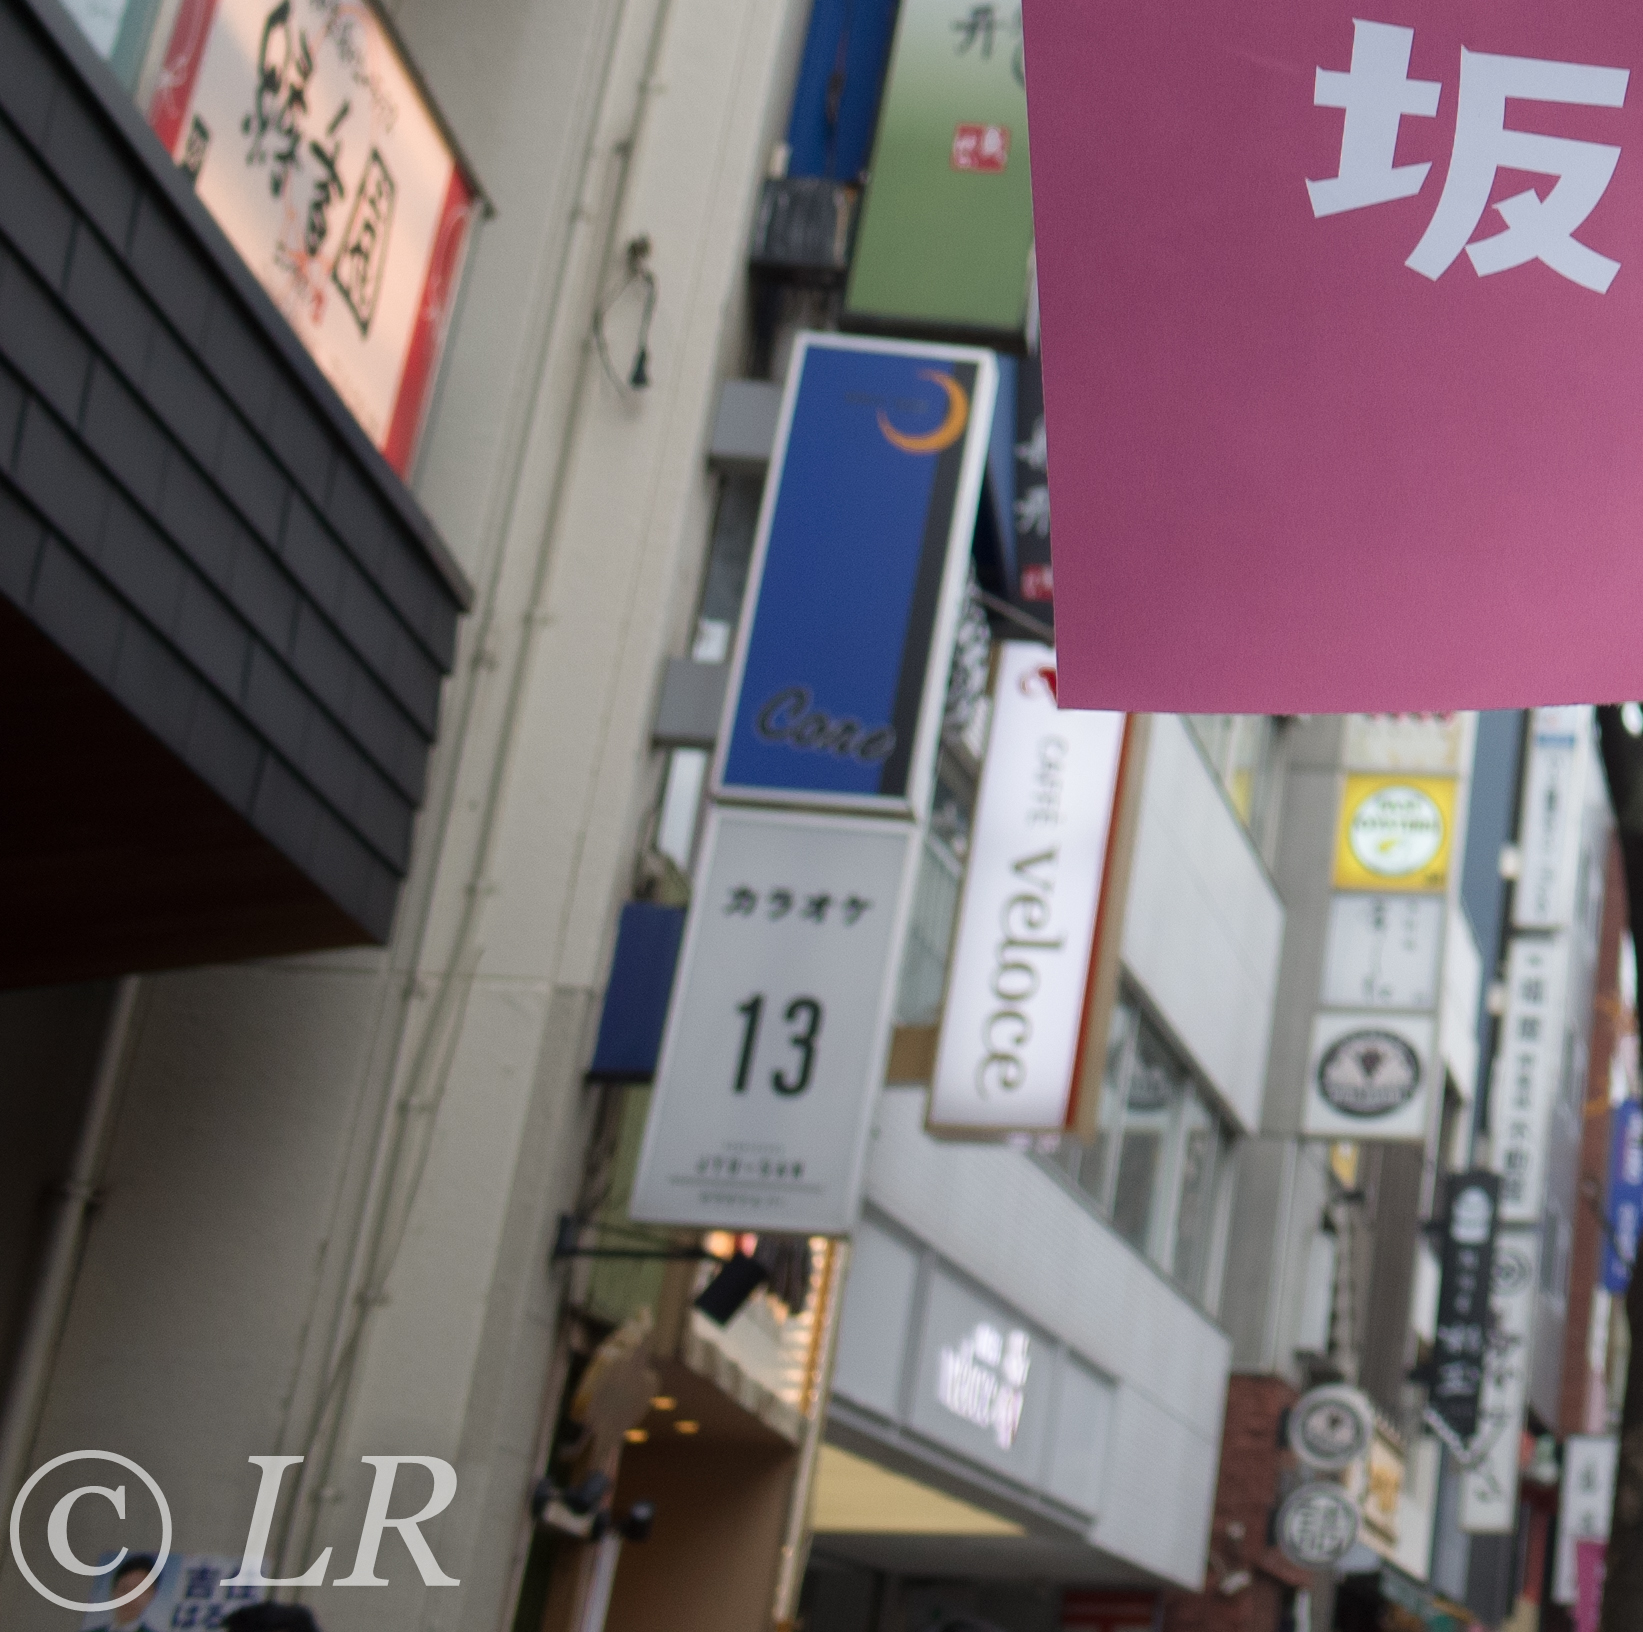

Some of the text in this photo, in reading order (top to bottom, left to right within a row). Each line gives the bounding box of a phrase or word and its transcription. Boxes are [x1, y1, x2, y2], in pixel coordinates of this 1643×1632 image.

[720, 883, 875, 929] カラオケ
[975, 845, 1069, 1100] veloce
[730, 992, 824, 1100] 13
